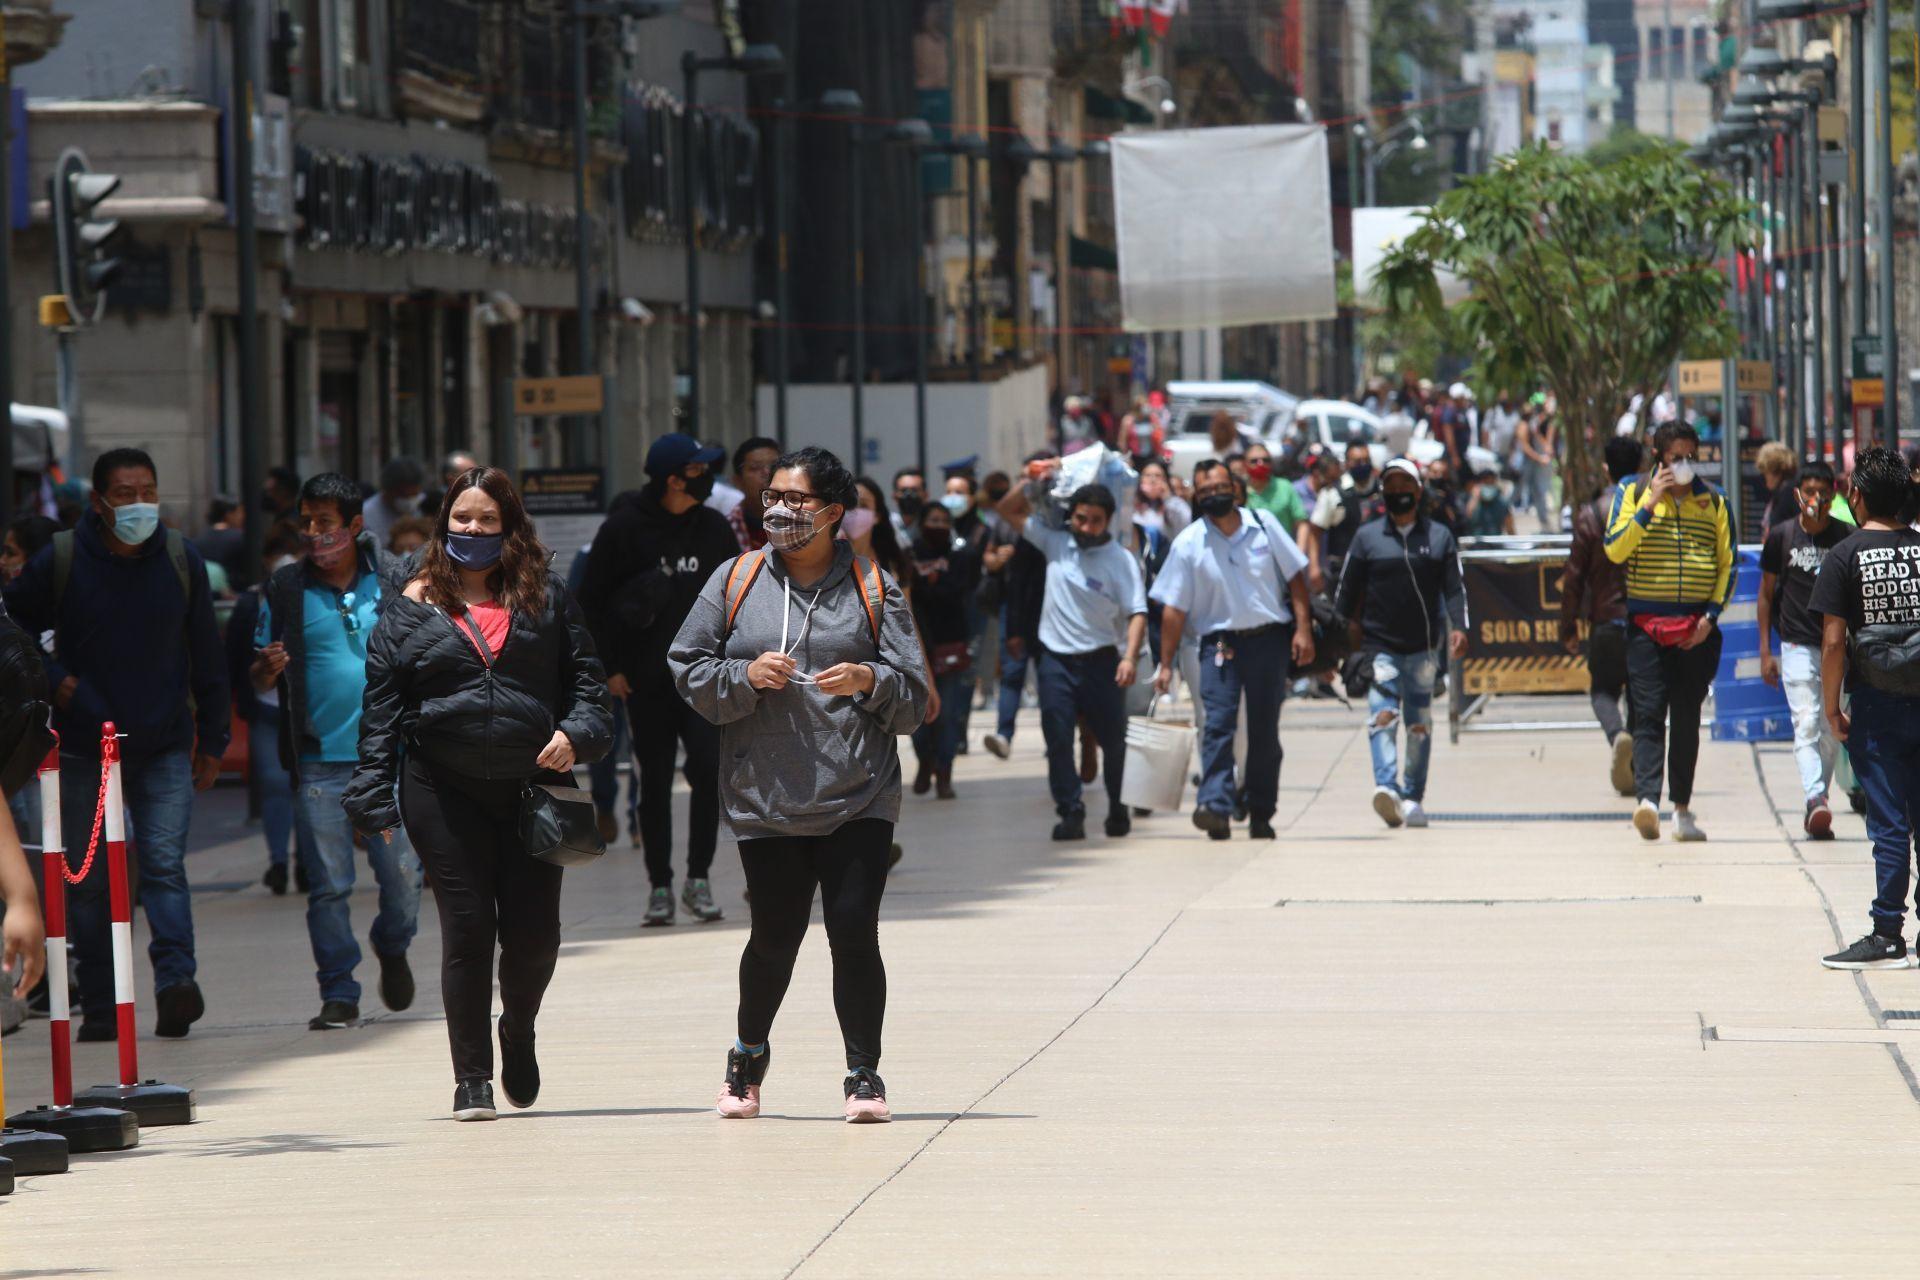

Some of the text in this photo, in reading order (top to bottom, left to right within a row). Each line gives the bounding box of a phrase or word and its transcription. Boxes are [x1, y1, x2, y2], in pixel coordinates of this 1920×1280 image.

[1857, 548, 1896, 565] KEEP
[1860, 562, 1910, 582] HEAD
[1862, 578, 1920, 598] GOD GI
[1863, 598, 1889, 610] HIS
[1481, 620, 1531, 643] SOLO
